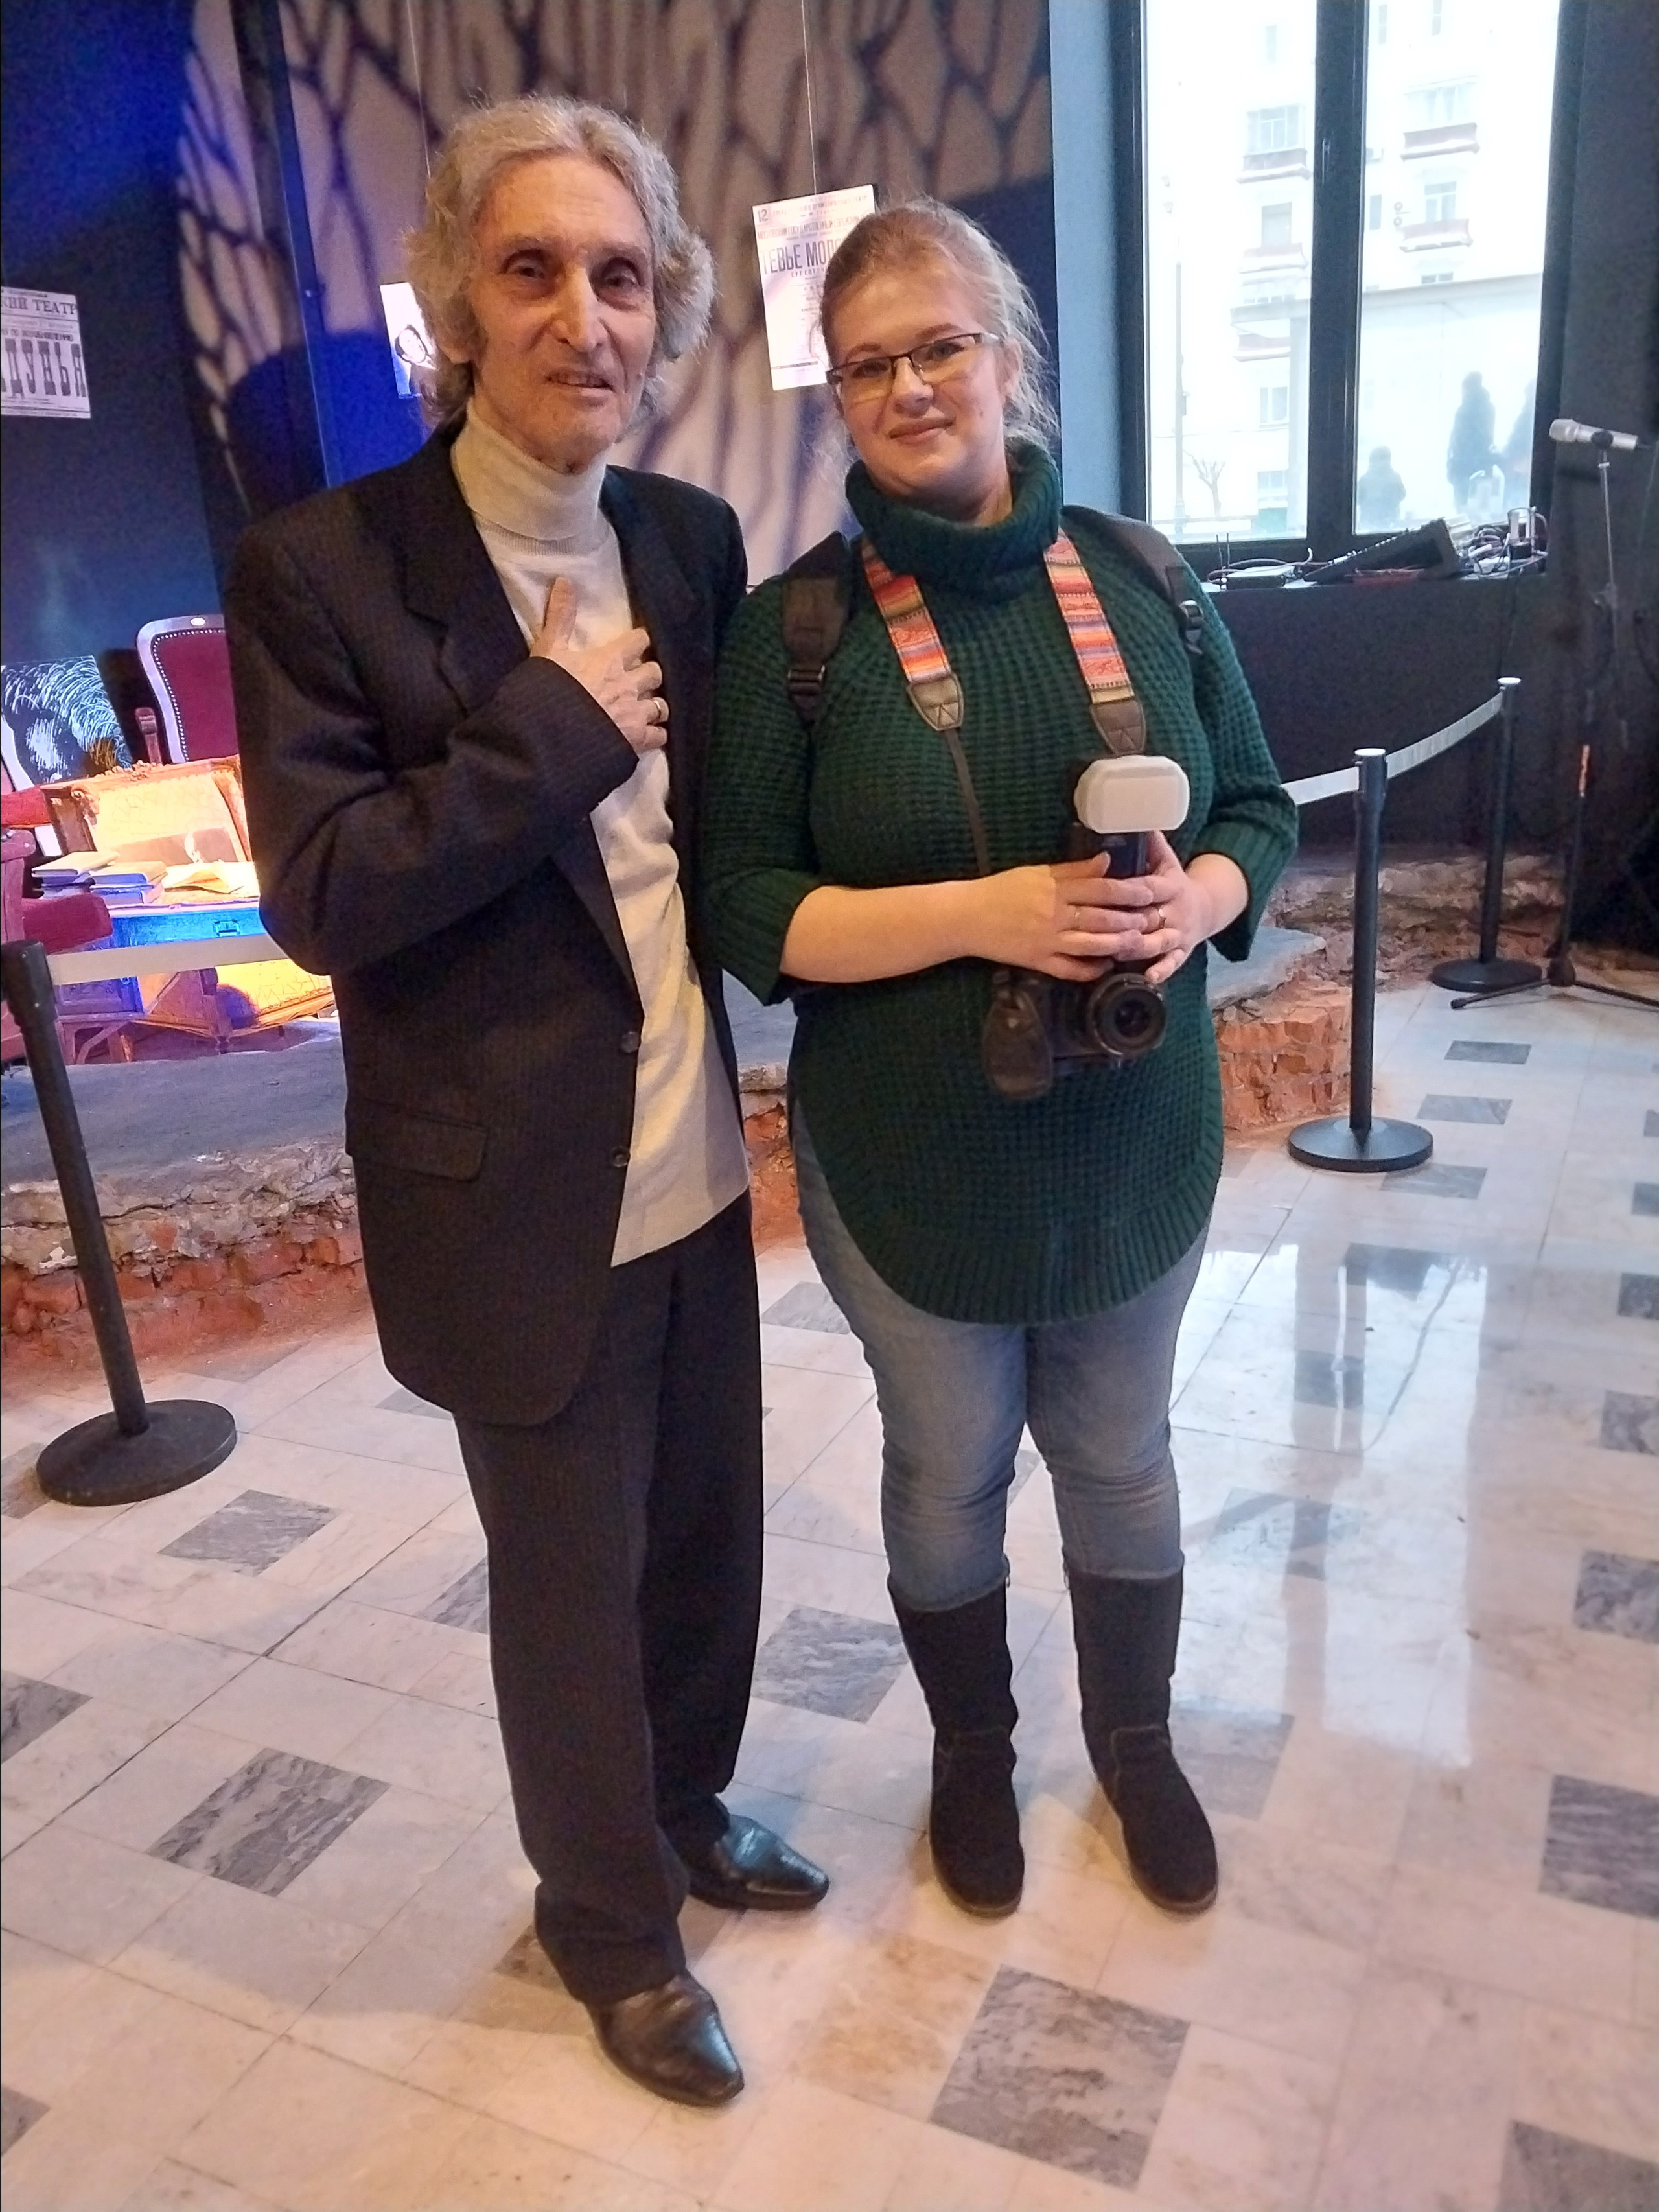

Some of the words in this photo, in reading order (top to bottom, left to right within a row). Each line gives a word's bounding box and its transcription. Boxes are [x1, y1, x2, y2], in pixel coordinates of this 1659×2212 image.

[757, 208, 769, 223] 12
[760, 244, 803, 274] ТЕВЬЕ
[32, 299, 77, 314] ТЕАТР
